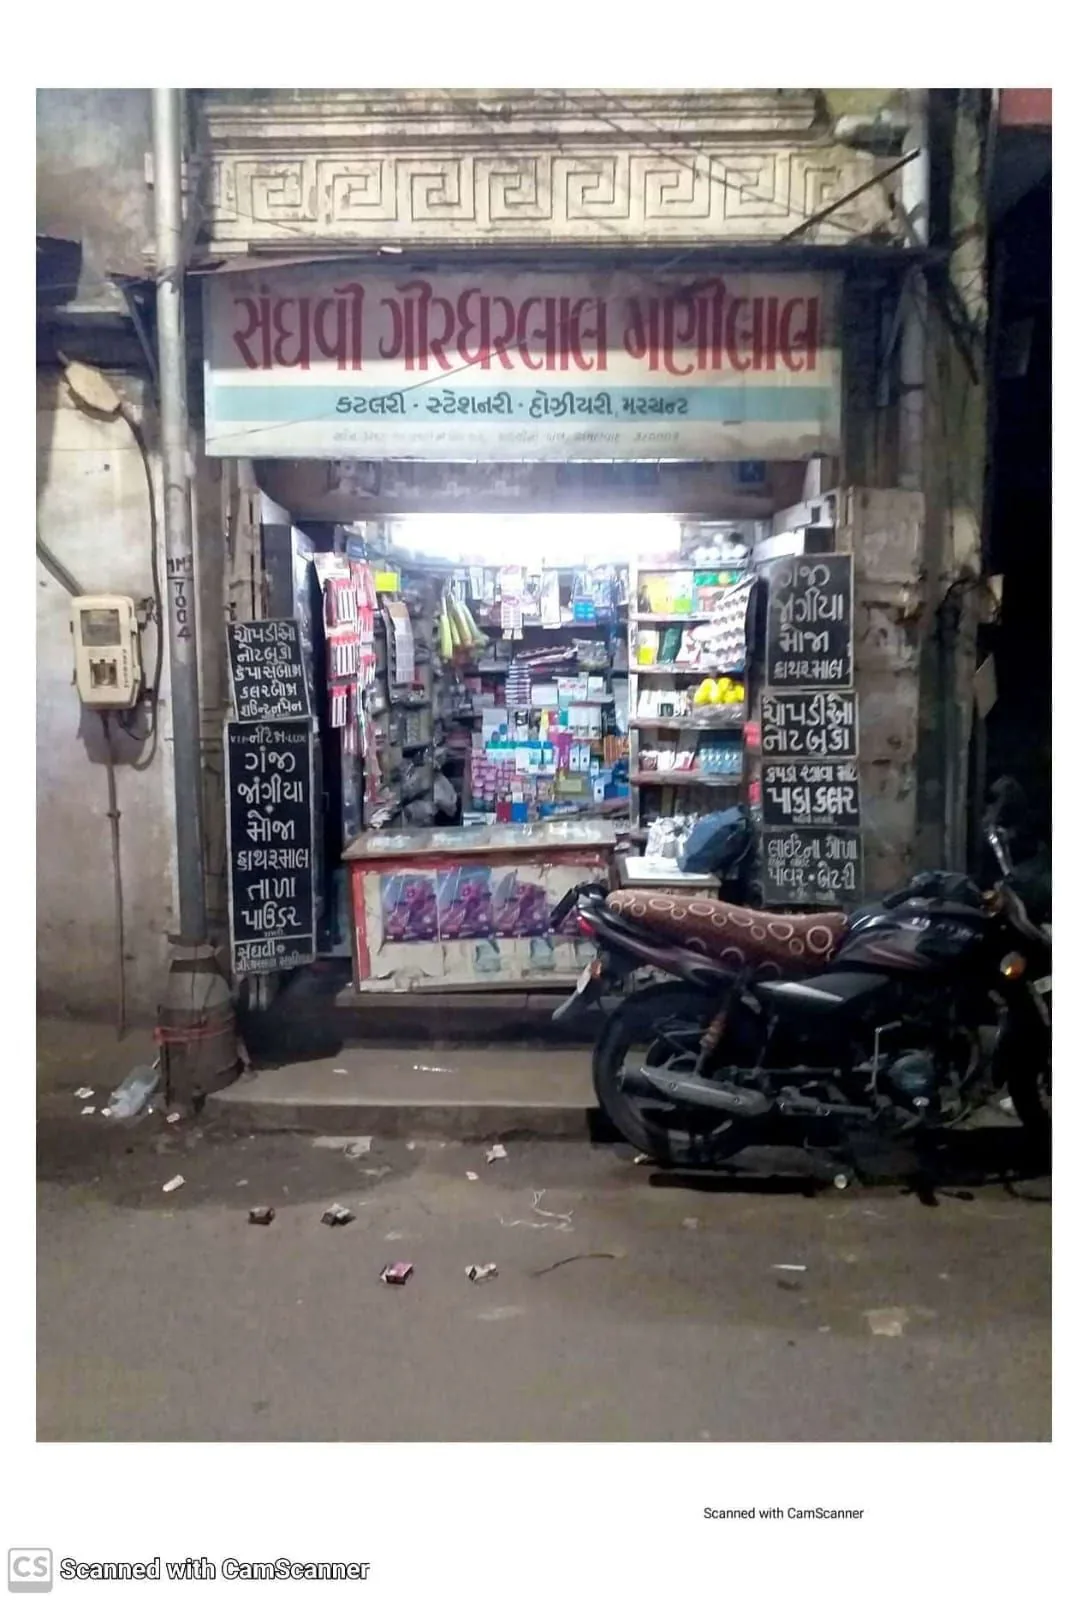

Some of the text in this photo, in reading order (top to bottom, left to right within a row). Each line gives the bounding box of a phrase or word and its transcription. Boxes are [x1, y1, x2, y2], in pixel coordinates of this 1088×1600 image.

[232, 281, 365, 371] સંઘવી
[622, 276, 820, 376] મણીલાલ
[335, 391, 406, 415] કટલરી
[425, 388, 514, 415] સ્ટેશનરી
[244, 745, 297, 773] ગંજી
[237, 773, 304, 805] જાંગીયા
[246, 877, 296, 900] તાળા
